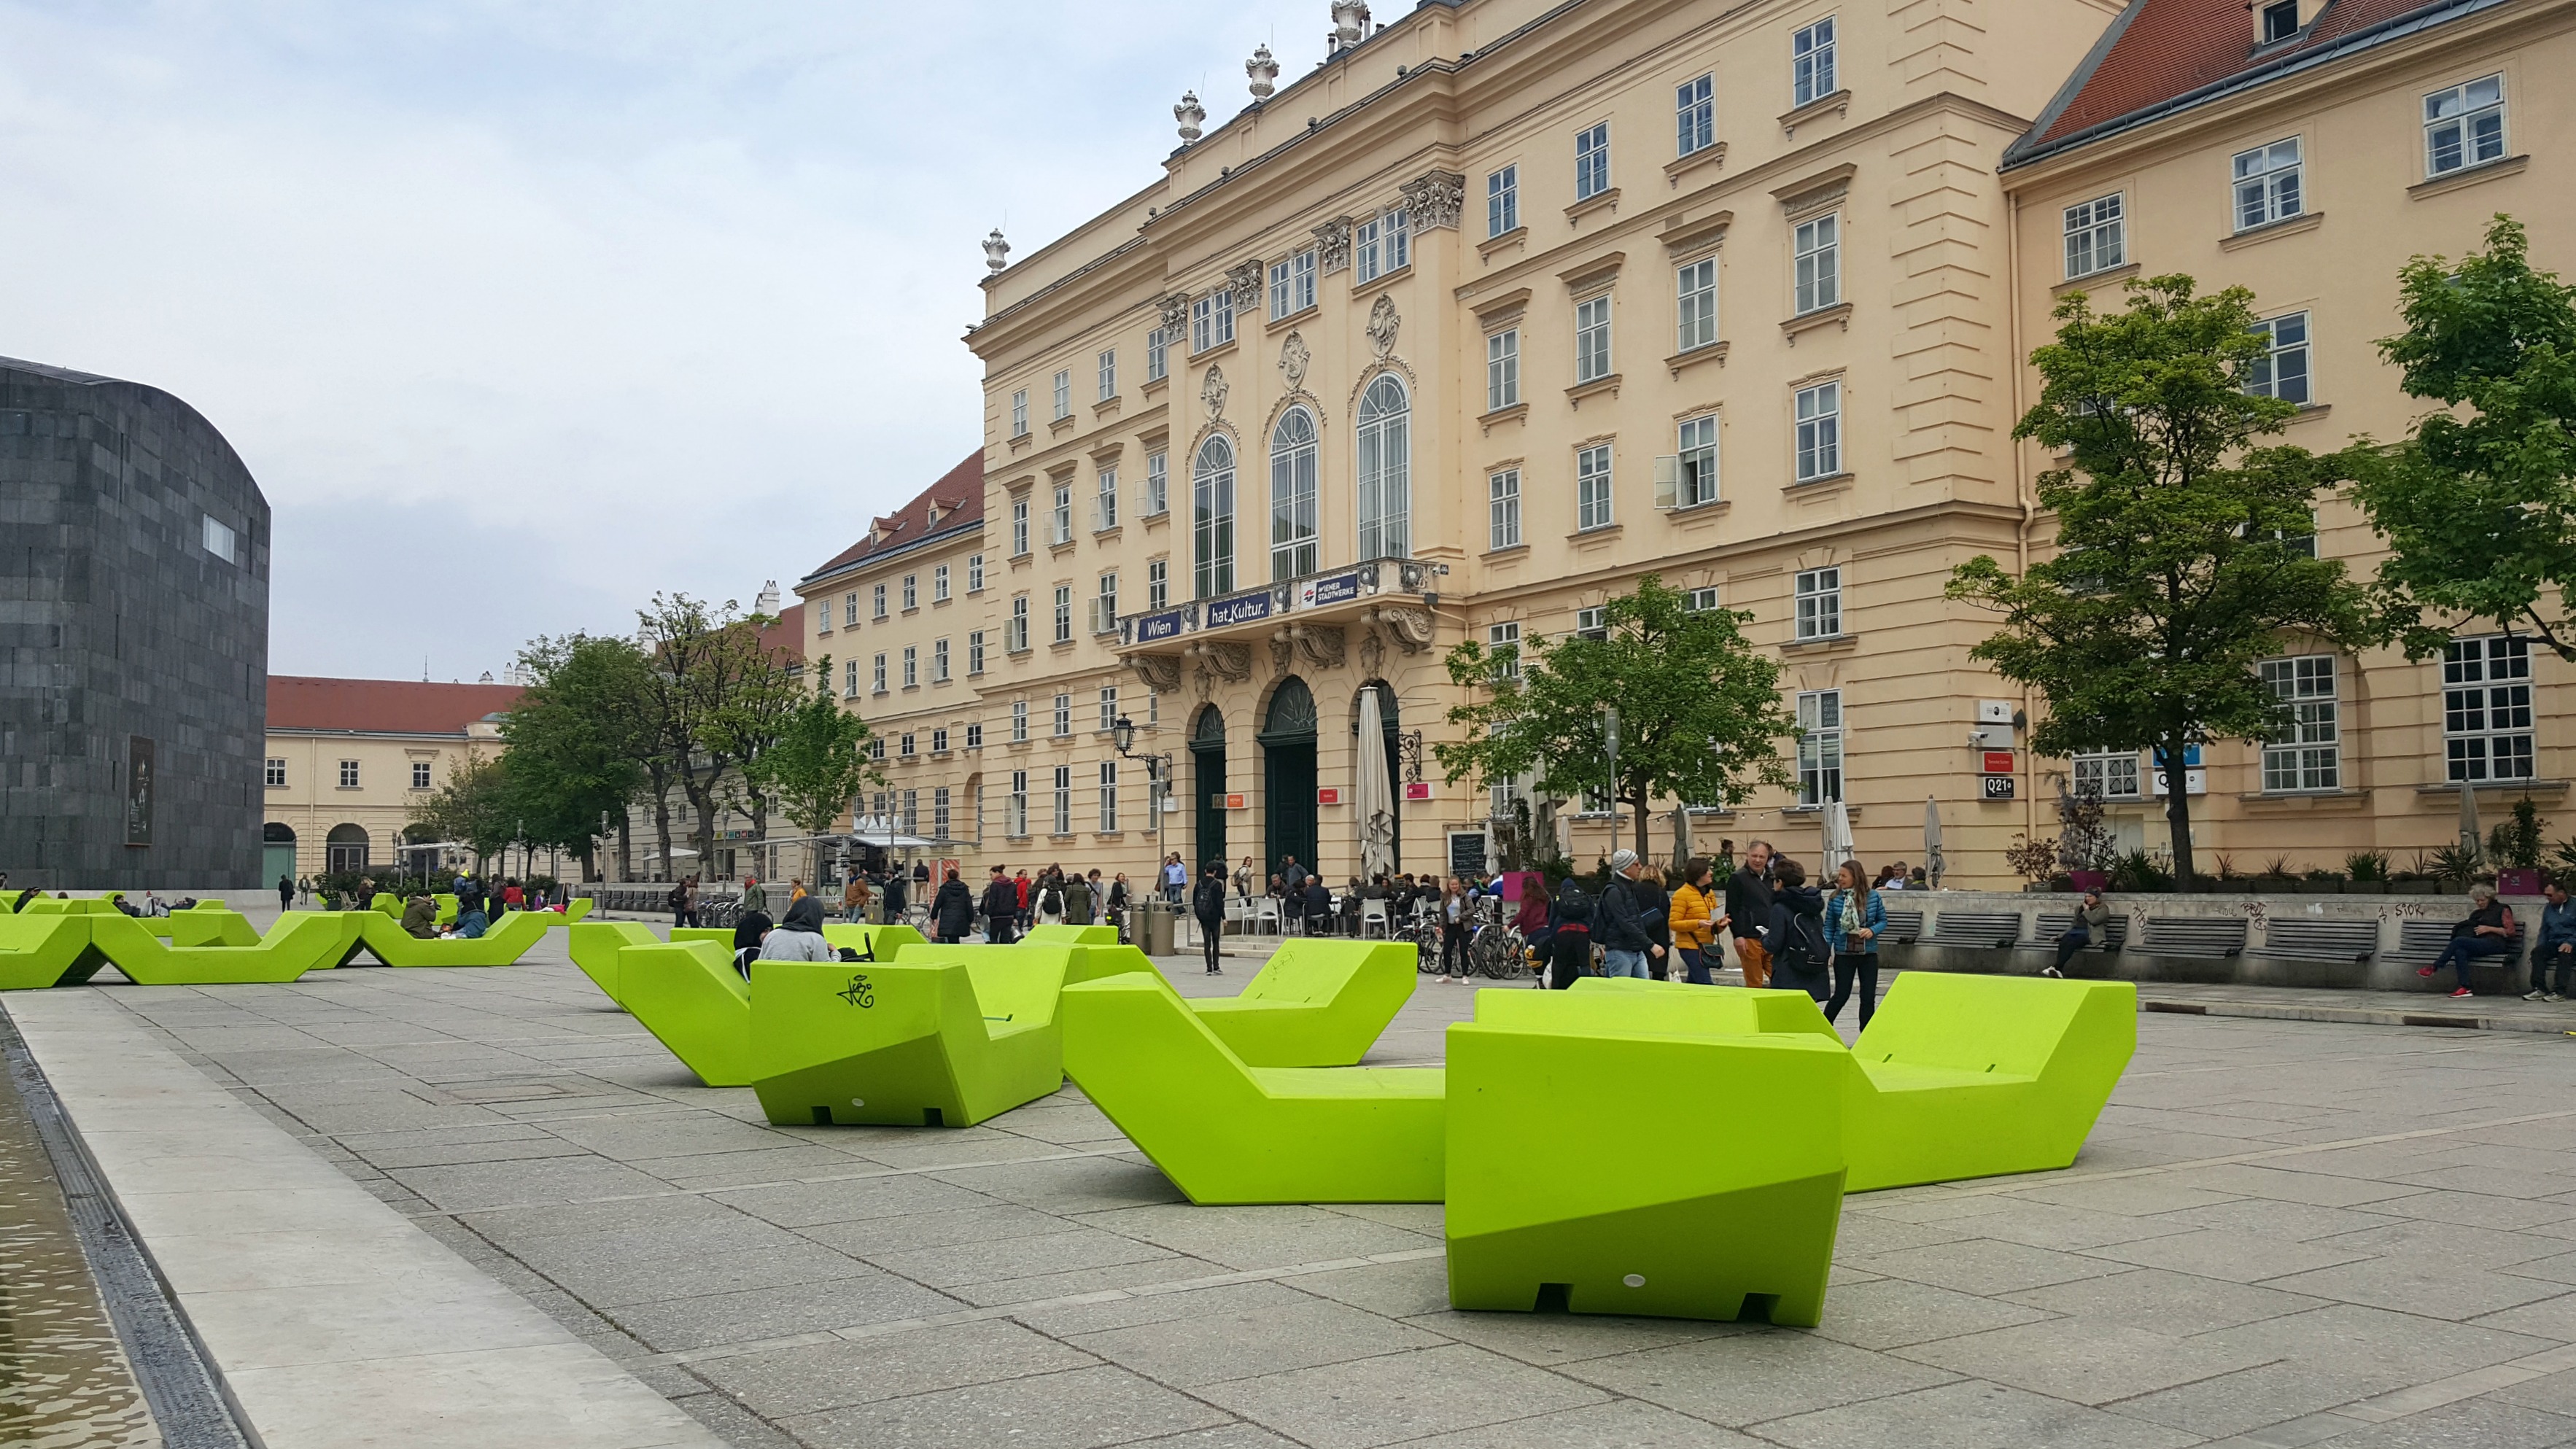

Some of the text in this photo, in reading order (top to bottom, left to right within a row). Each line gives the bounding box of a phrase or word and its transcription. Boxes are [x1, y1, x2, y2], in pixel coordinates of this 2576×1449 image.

[1317, 586, 1354, 602] STADTWERKE
[1318, 582, 1341, 593] WIENER
[1147, 600, 1264, 637] Wien hat Kultur.
[1987, 779, 2006, 793] Q21
